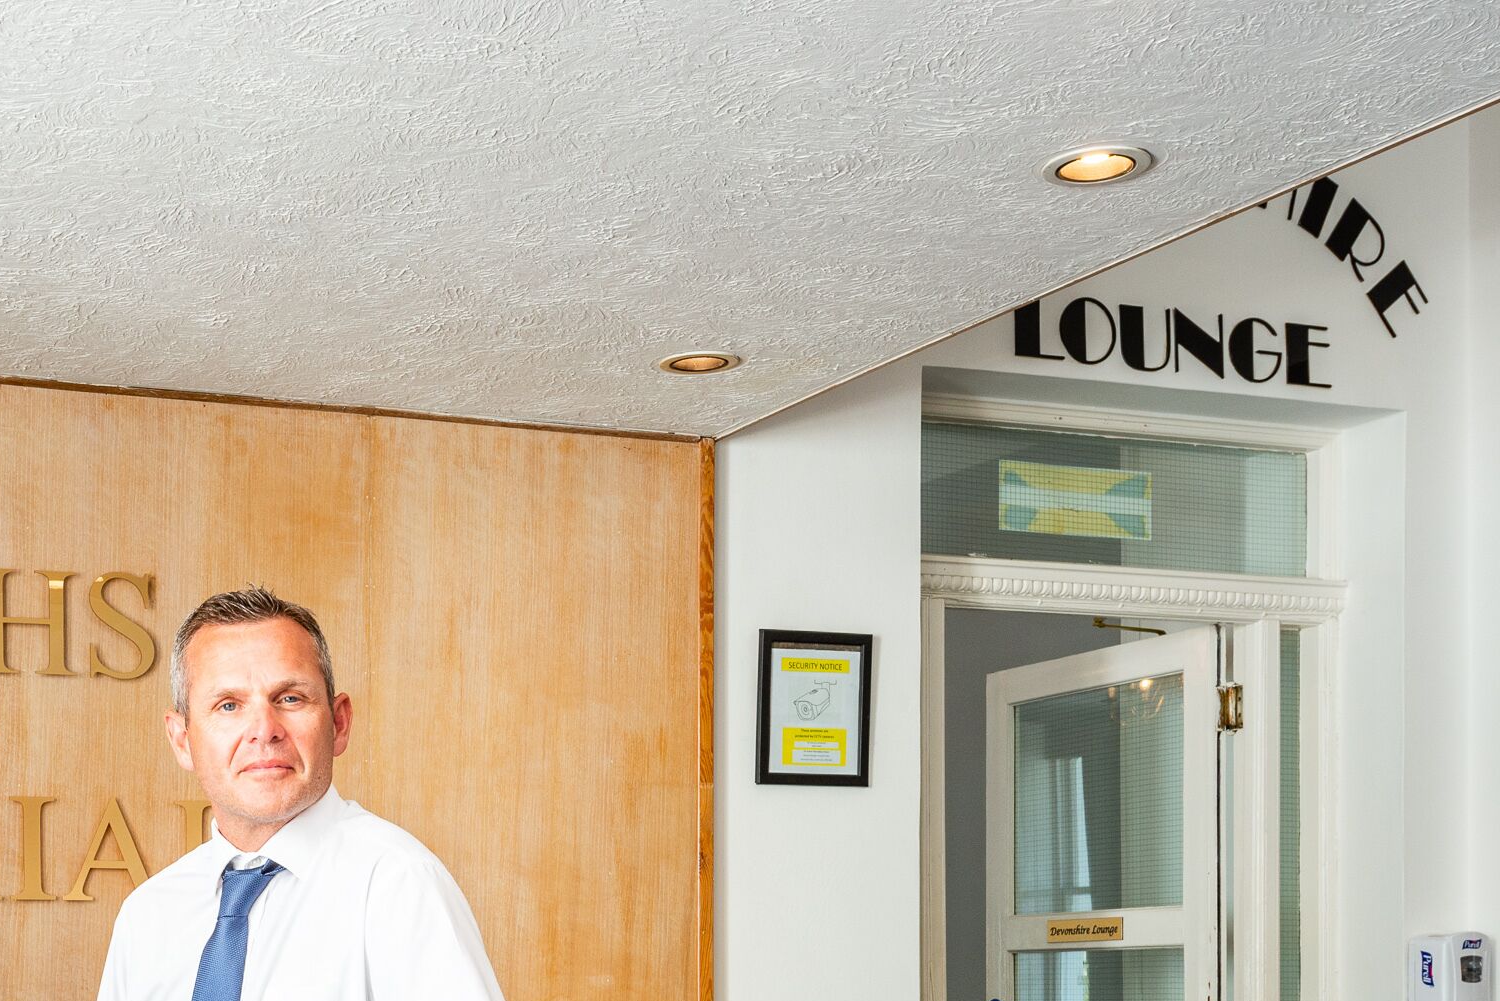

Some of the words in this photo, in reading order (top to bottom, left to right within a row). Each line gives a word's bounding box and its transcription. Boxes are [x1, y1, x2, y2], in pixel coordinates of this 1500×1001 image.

[1014, 297, 1332, 388] LOUNGE
[788, 662, 818, 670] SECURITY
[1050, 924, 1090, 936] Devonshire
[1092, 925, 1118, 936] Lounge
